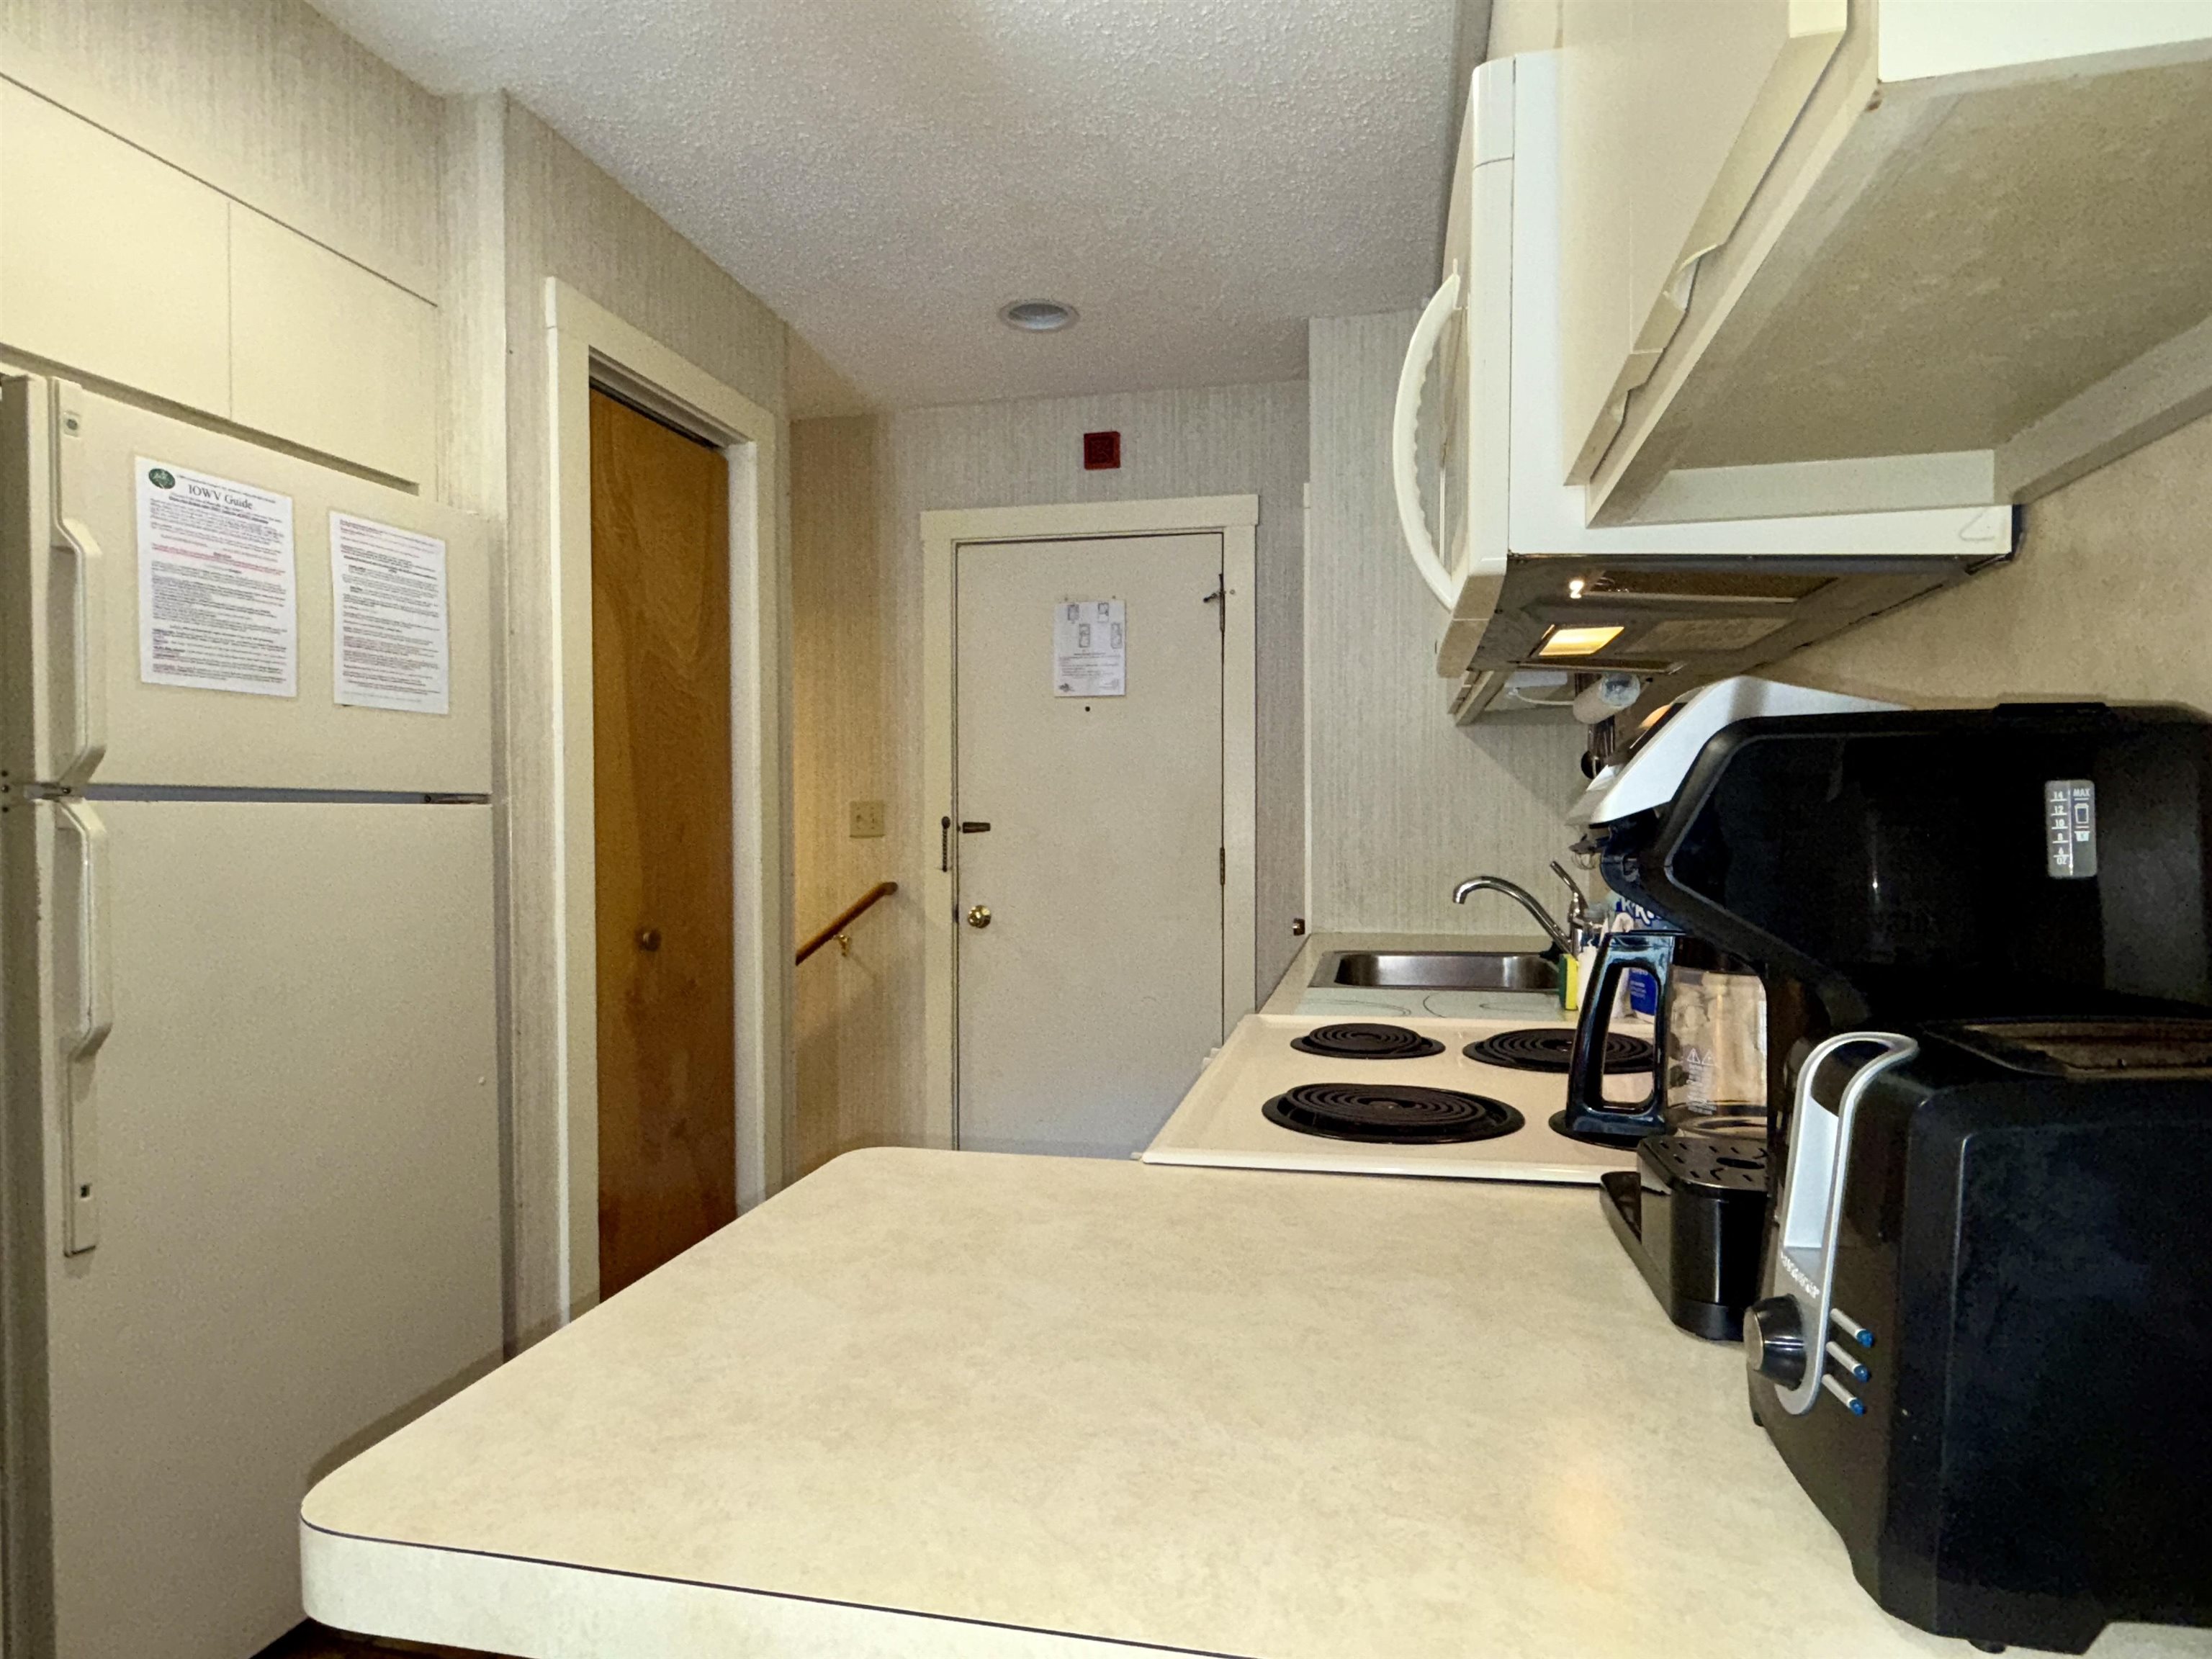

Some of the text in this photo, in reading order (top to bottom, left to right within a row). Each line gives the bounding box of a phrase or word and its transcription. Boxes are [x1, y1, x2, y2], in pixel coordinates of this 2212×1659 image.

[188, 484, 222, 500] IOWV
[225, 494, 253, 509] Guide
[2074, 788, 2090, 797] MAX
[2054, 805, 2064, 814] 12
[2055, 819, 2065, 827] 10
[2057, 832, 2064, 841] 8
